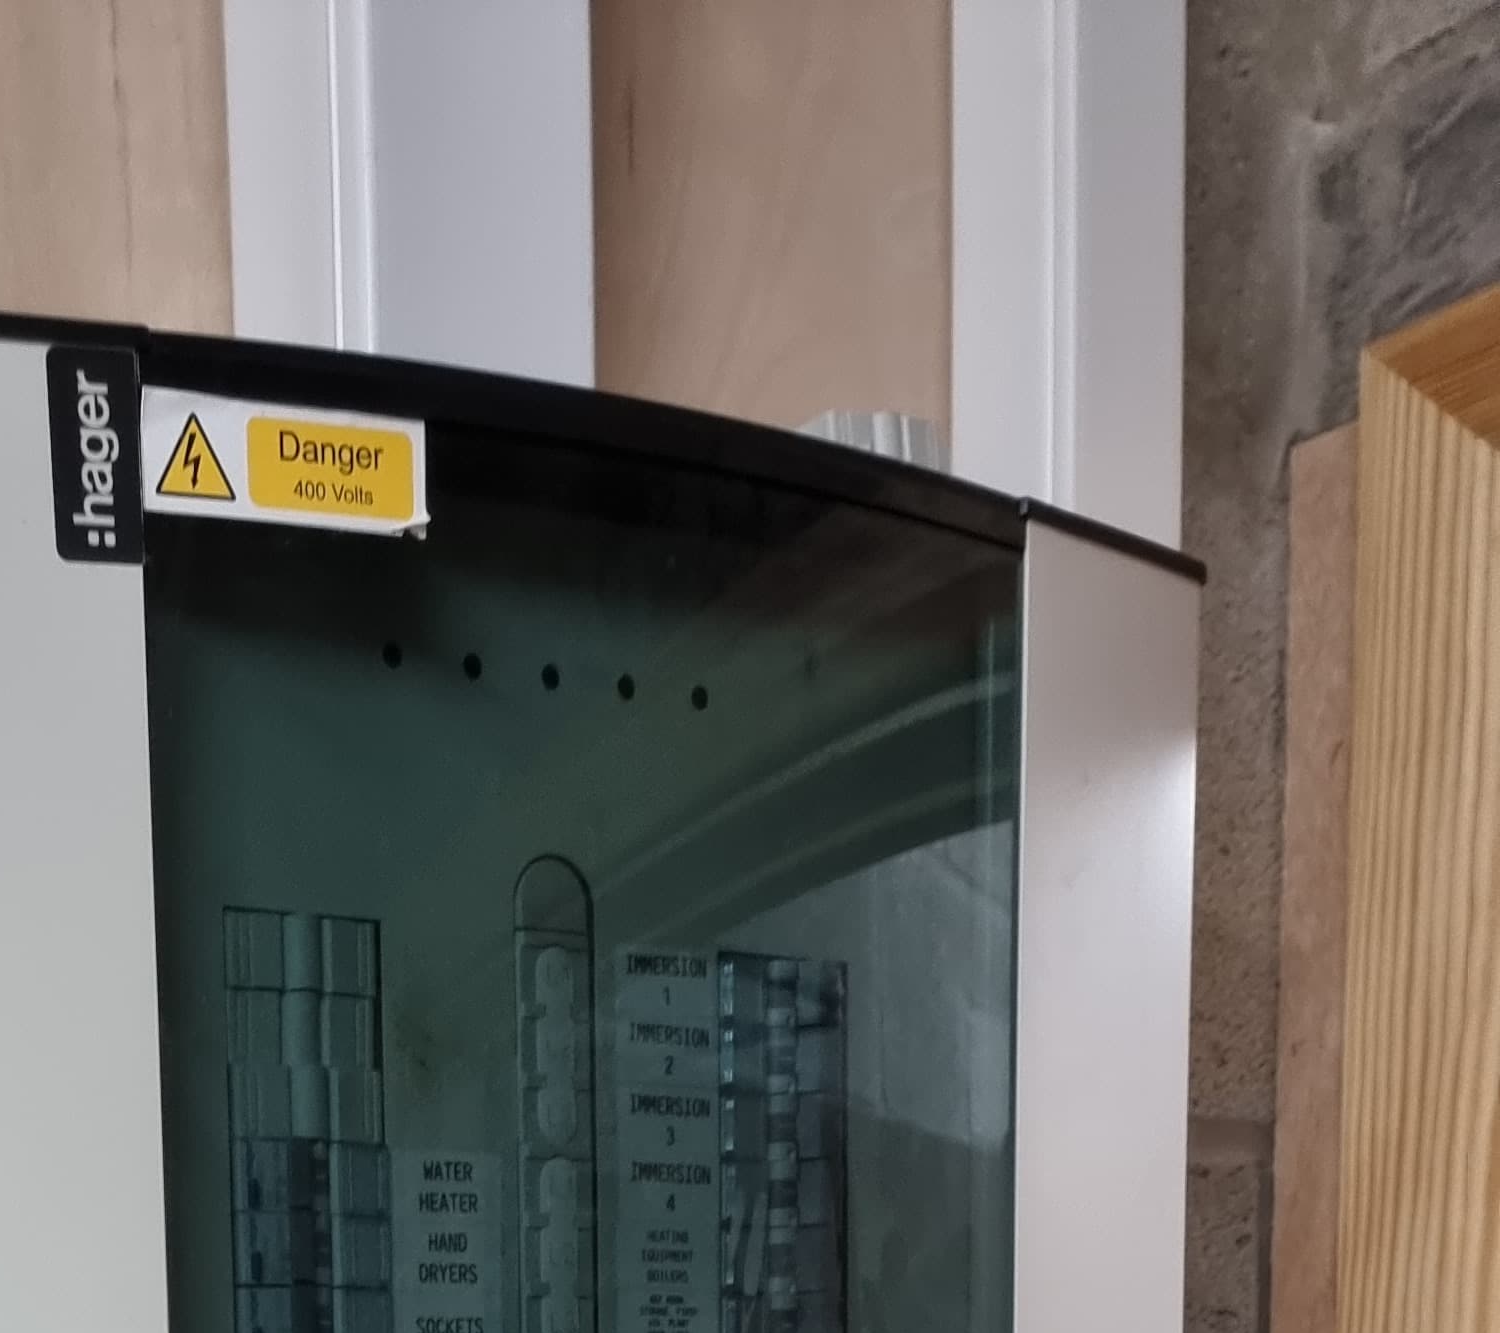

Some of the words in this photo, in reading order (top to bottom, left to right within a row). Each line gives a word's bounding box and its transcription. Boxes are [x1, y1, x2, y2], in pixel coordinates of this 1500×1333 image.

[279, 431, 383, 475] Danger
[294, 479, 326, 502] 400
[333, 484, 373, 506] Volts
[625, 953, 707, 979] IMMERSION
[662, 986, 671, 1006] 1
[629, 1022, 710, 1049] IMMERSION
[664, 1055, 674, 1076] 2
[630, 1092, 710, 1118] IMMERSION
[666, 1125, 675, 1147] 3
[423, 1160, 473, 1183] WATER
[630, 1160, 711, 1185] IMMERSION
[419, 1192, 478, 1214] HEATER
[666, 1192, 676, 1212] 4
[428, 1232, 468, 1254] HAND
[418, 1262, 478, 1285] DRYERS
